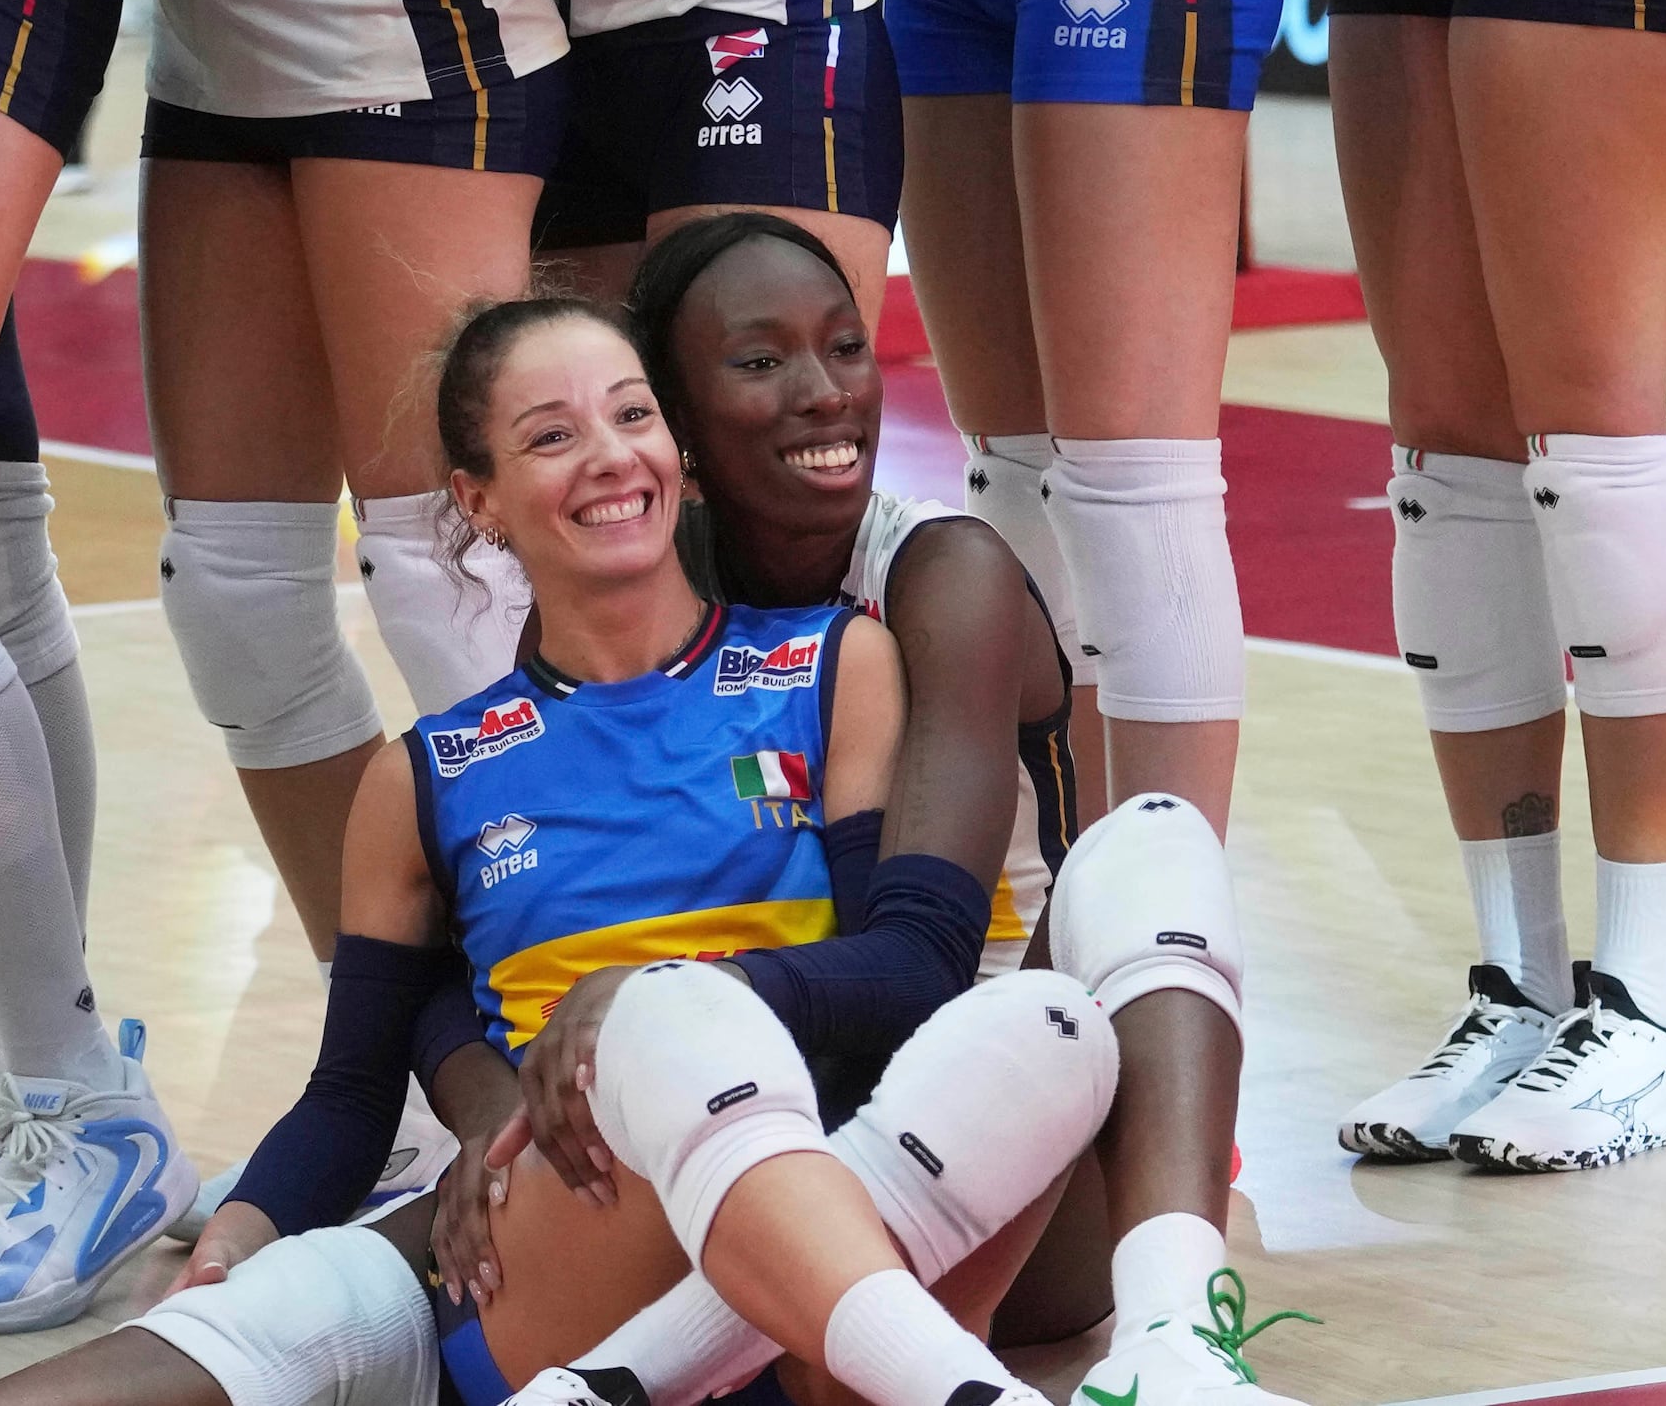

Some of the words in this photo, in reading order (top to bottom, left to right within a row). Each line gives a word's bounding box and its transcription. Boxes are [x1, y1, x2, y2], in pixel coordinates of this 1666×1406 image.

[720, 641, 818, 675] BigMat
[762, 674, 811, 687] BUILDERS
[431, 701, 535, 758] BigMat
[472, 747, 487, 758] OF
[487, 726, 542, 753] BUILDERS
[750, 800, 813, 830] ITA
[24, 1093, 60, 1110] NIKE
